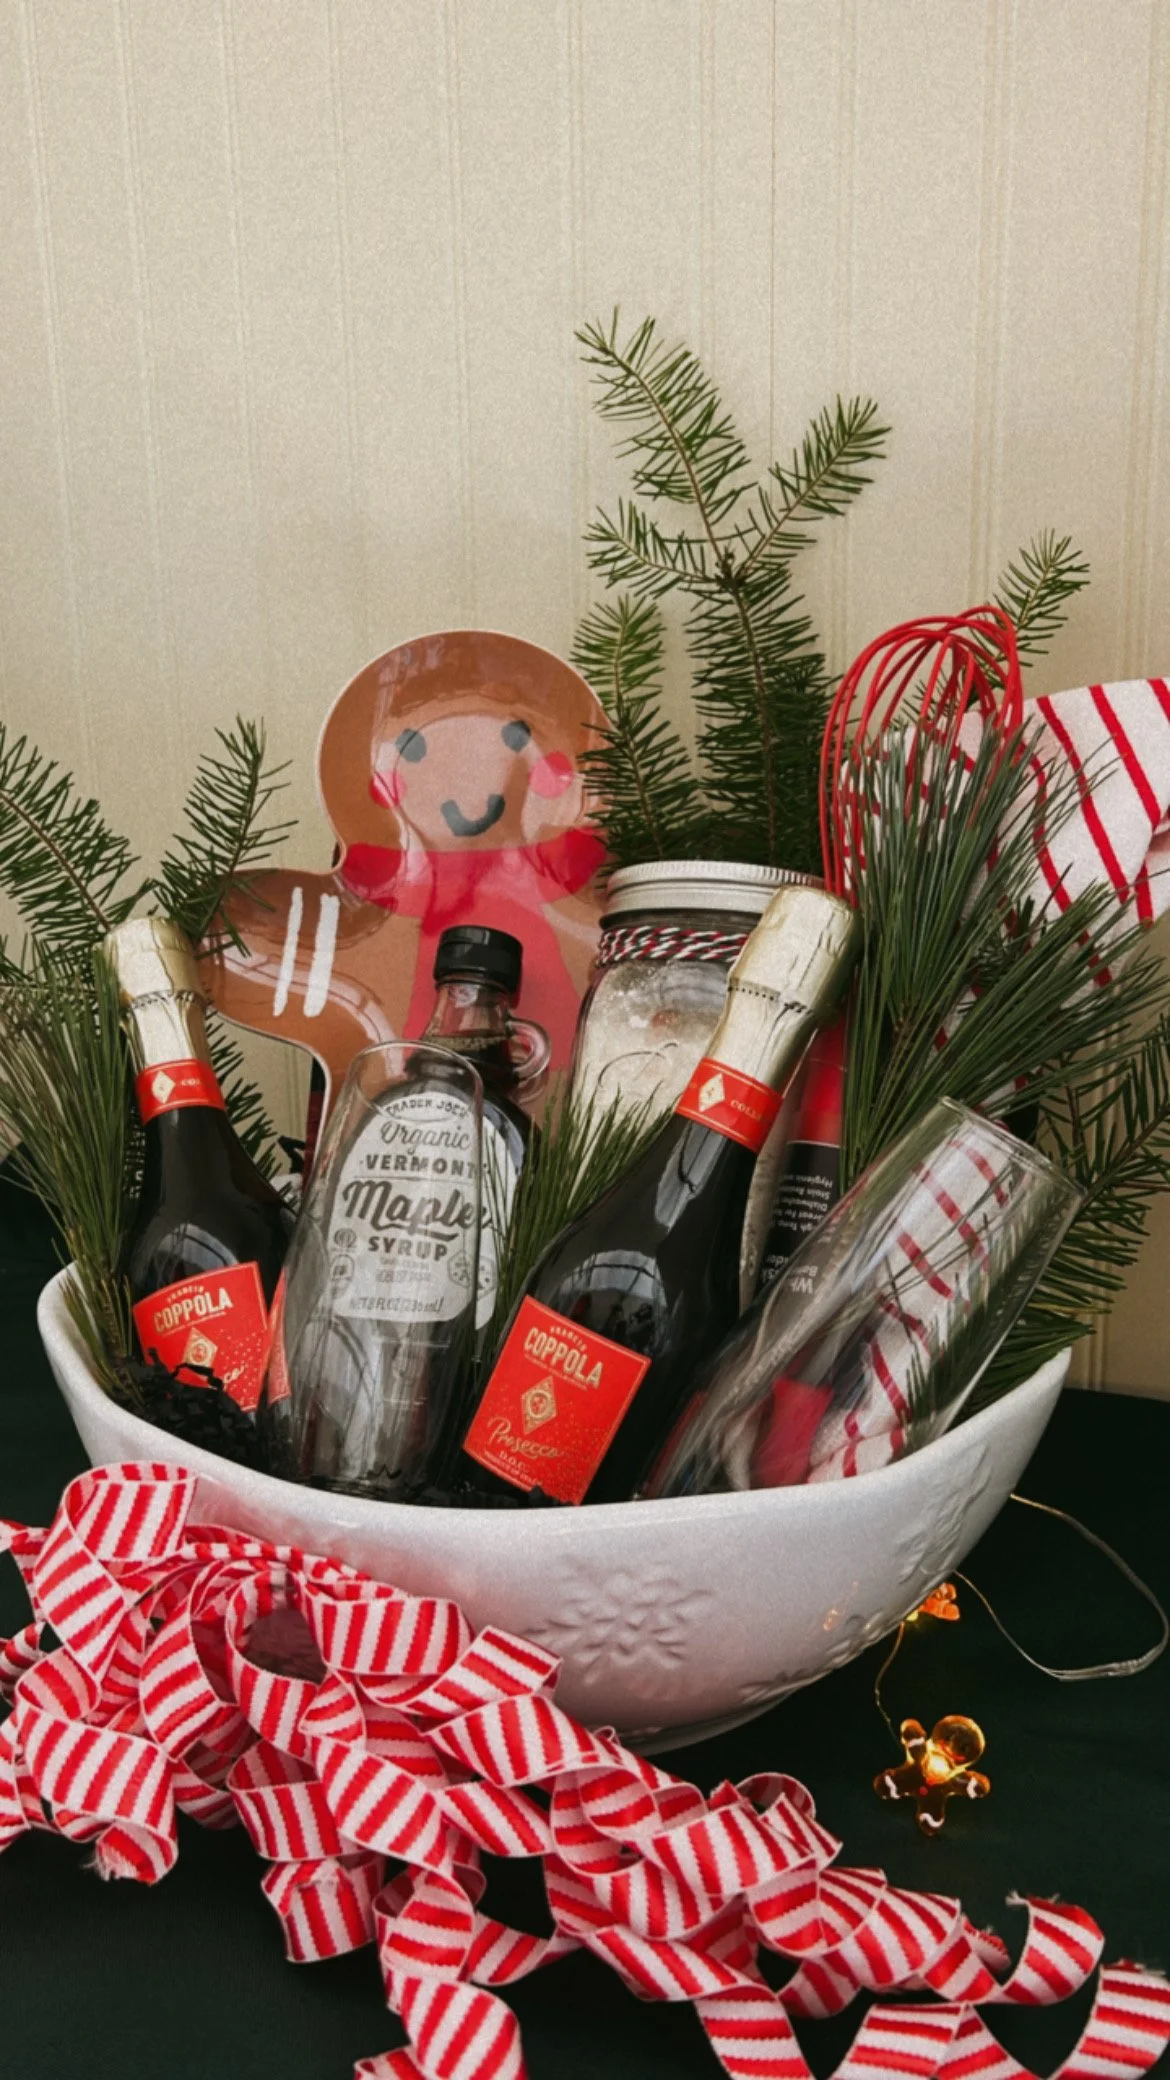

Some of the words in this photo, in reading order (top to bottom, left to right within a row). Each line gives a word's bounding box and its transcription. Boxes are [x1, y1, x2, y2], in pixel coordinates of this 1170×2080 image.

[381, 1120, 471, 1155] Organic
[366, 1154, 476, 1179] VERMONT
[342, 1180, 478, 1242] Maple
[368, 1236, 447, 1261] SYRUP
[153, 1287, 234, 1333] COPPOLA
[523, 1327, 604, 1389] COPPOLA
[487, 1416, 564, 1460] Prosecco
